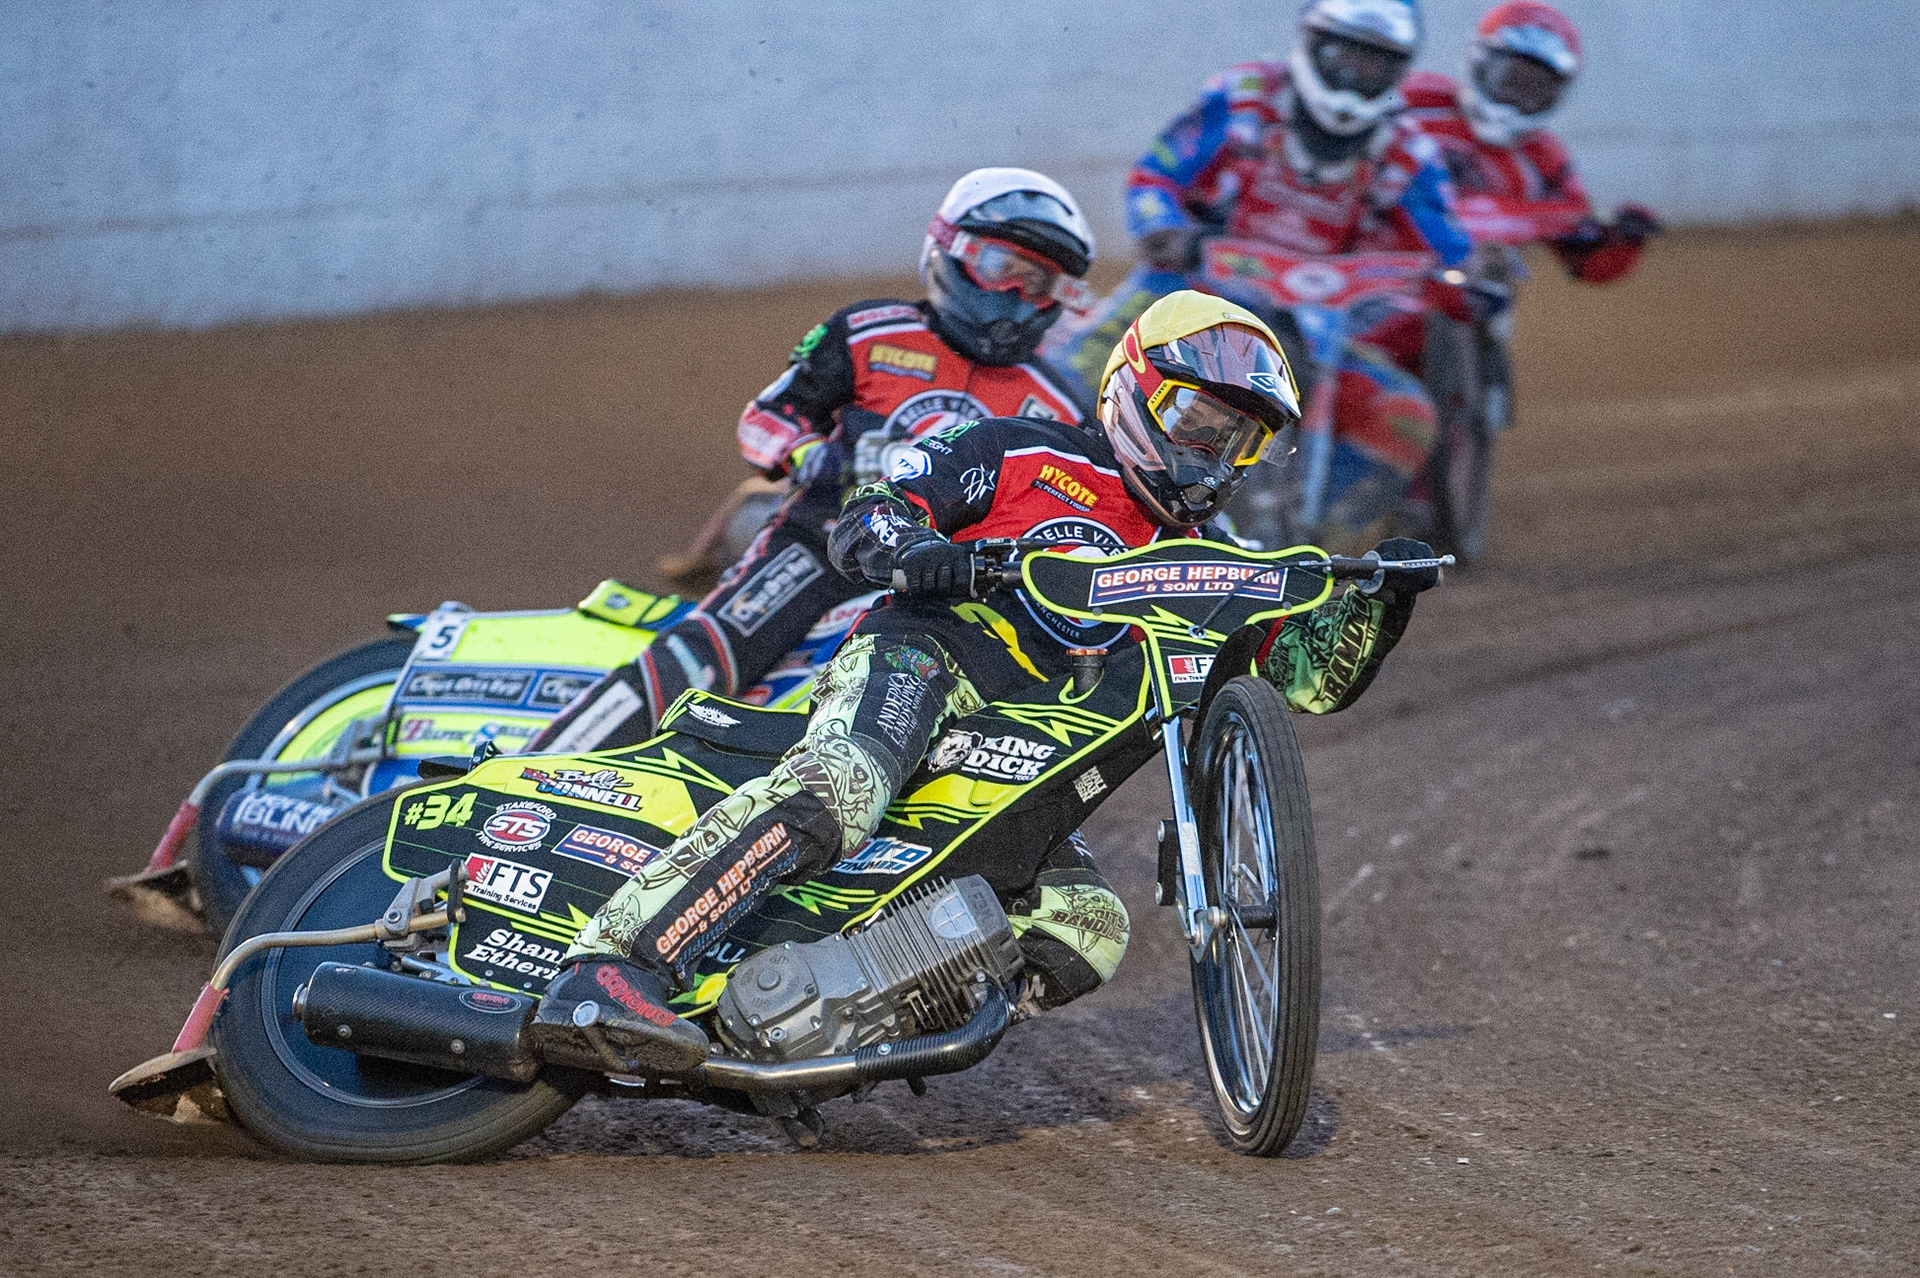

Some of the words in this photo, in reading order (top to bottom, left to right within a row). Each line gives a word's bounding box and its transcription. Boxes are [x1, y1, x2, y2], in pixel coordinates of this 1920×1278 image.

[1039, 465, 1097, 506] HYCOTE
[1043, 483, 1071, 503] PERFECT
[1096, 567, 1182, 588] GEORGE
[1146, 582, 1157, 593] &
[1162, 582, 1199, 592] SON
[1204, 582, 1234, 592] LTD
[430, 625, 458, 649] 5
[981, 735, 1056, 760] KING
[965, 749, 1046, 776] DICK
[404, 792, 478, 830] #34
[495, 800, 557, 820] STAKEFORD
[486, 815, 549, 838] STS
[491, 840, 542, 853] SERVICES
[571, 829, 652, 863] GEORGE
[604, 854, 619, 865] &
[619, 860, 645, 875] SO
[487, 862, 548, 899] FTS
[655, 887, 719, 955] GEORGE
[716, 822, 789, 896] HEPBURN
[472, 884, 503, 902] Training
[503, 894, 537, 910] Services
[699, 920, 709, 933] &
[711, 893, 738, 922] SON
[483, 928, 566, 965] Shan
[469, 943, 561, 981] Etheri
